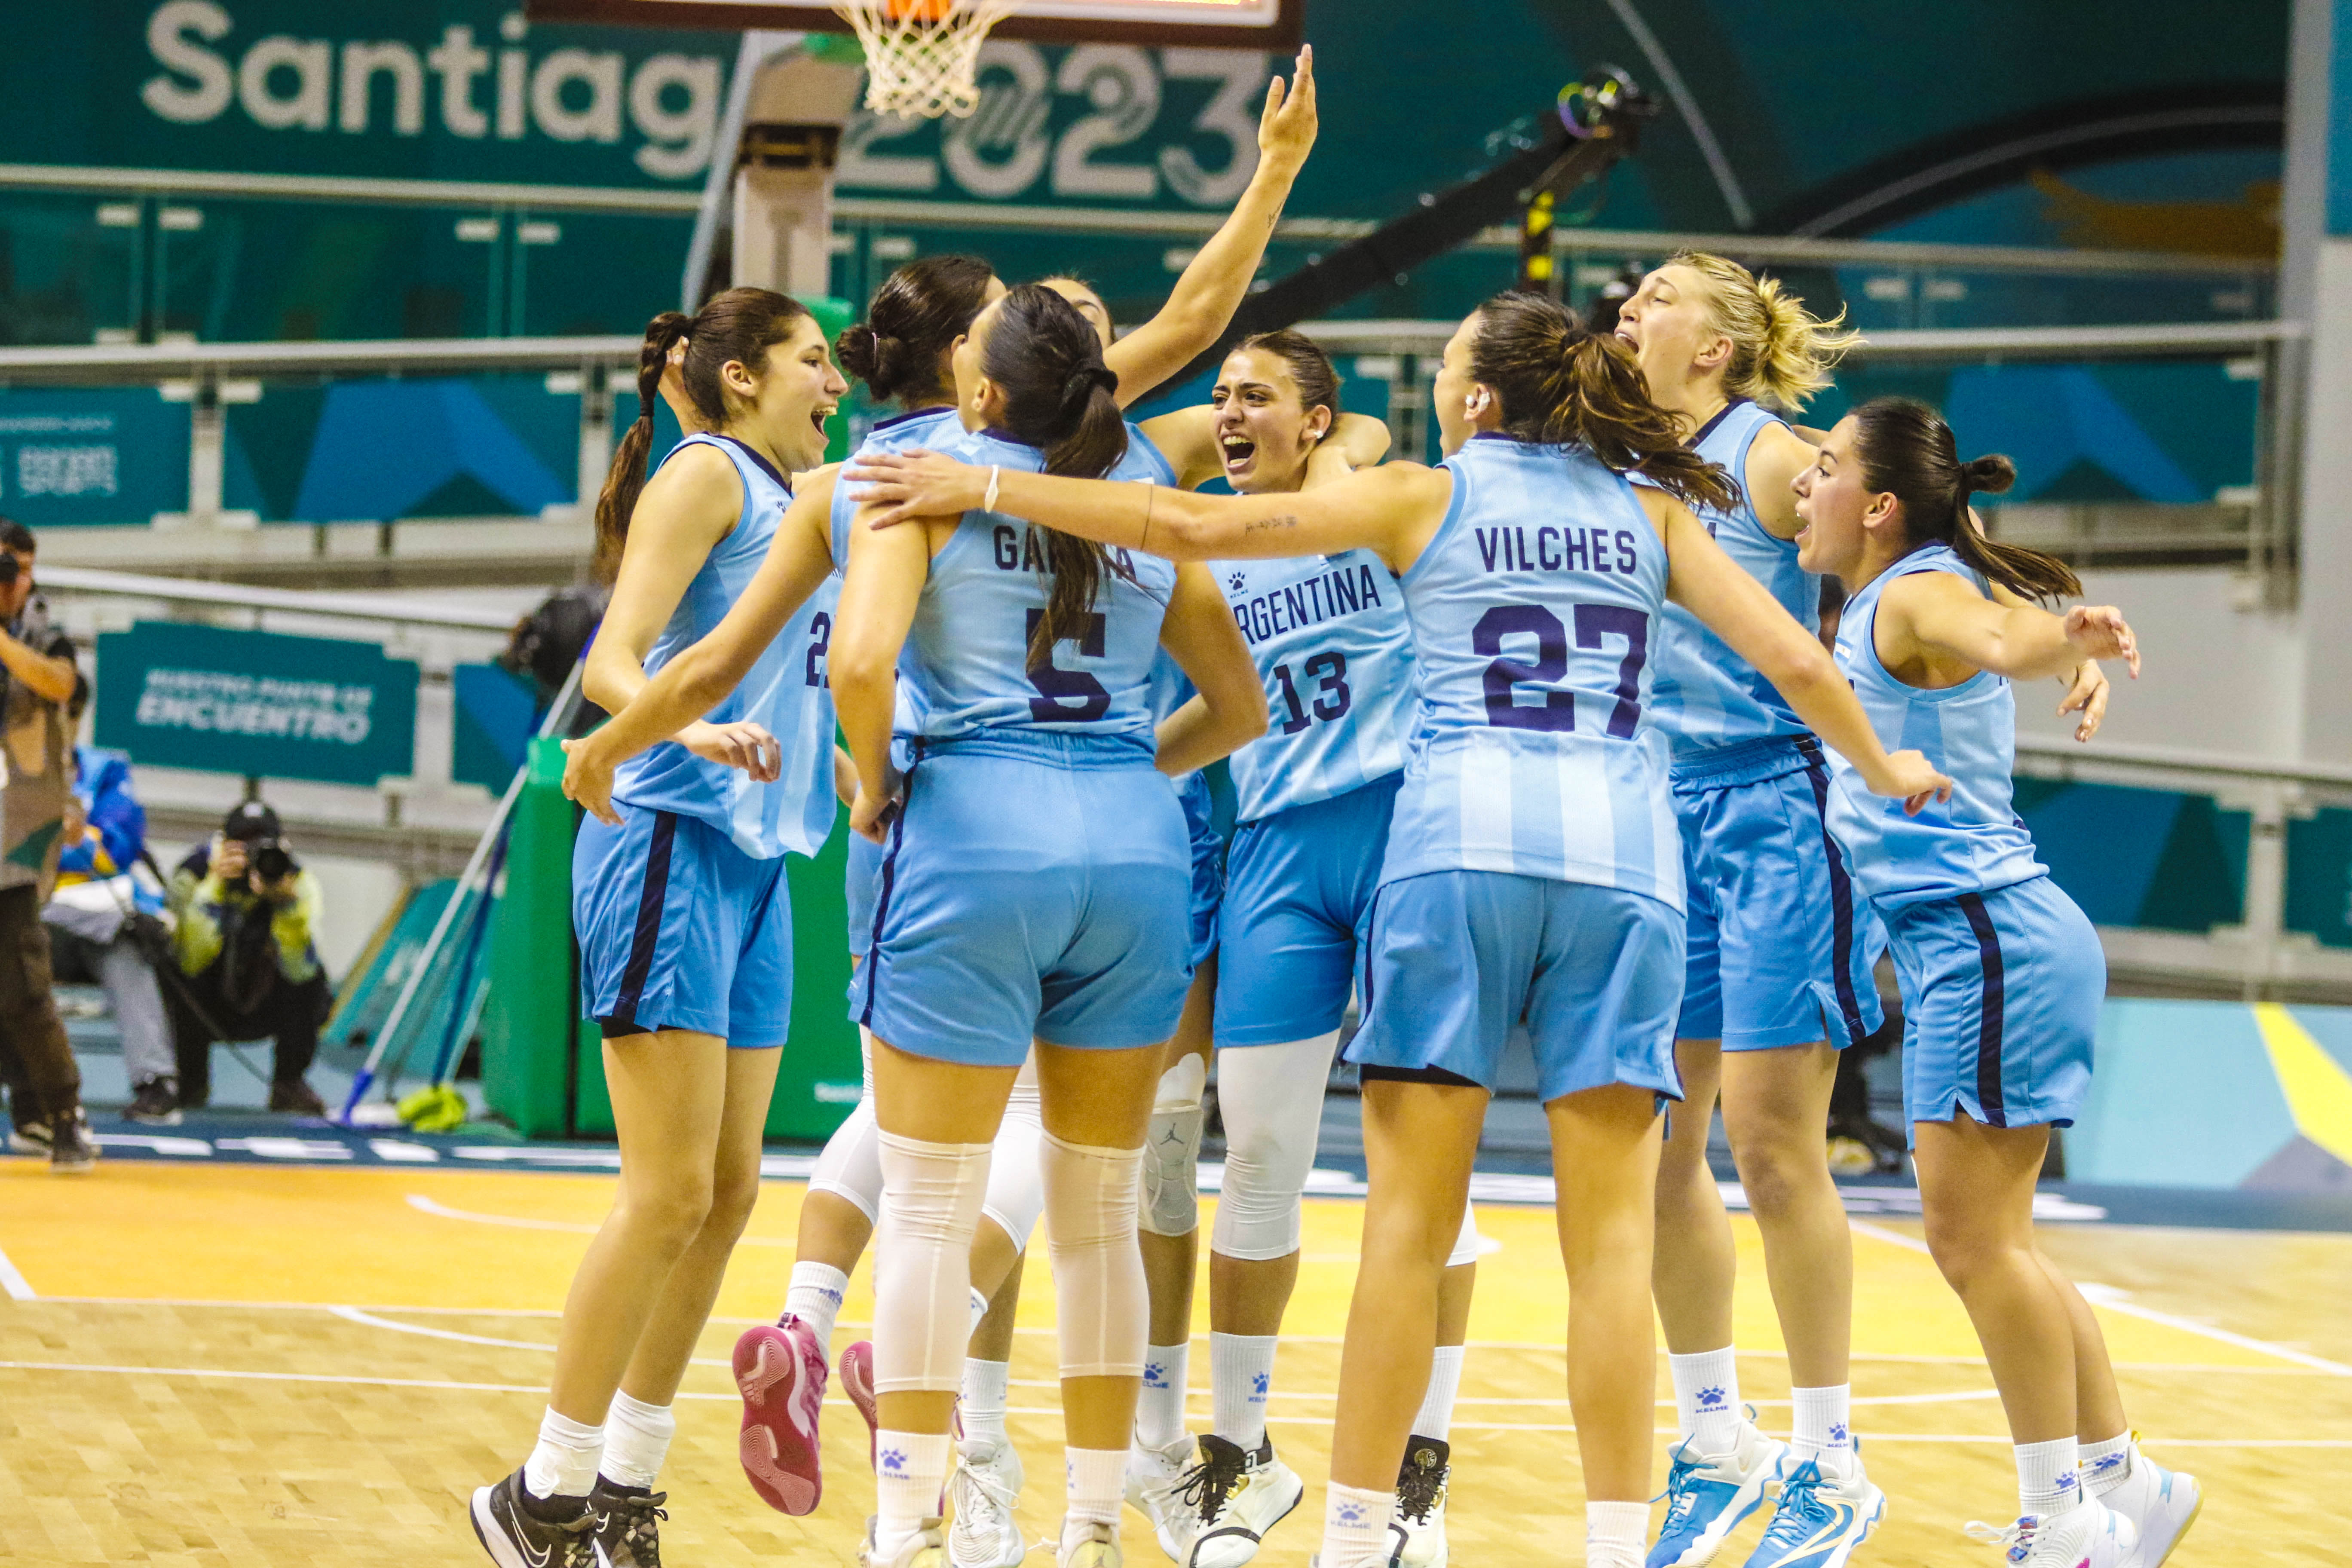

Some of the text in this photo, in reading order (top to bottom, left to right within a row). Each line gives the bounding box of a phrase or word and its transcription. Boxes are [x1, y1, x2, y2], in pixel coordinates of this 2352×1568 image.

[140, 0, 1269, 207] Santiag 2023
[1475, 527, 1636, 574] VILCHES
[1233, 564, 1381, 645] RGENTINA
[1026, 607, 1111, 723] 5
[1274, 651, 1351, 735] 13
[1472, 604, 1649, 739] 27
[137, 692, 371, 745] ENCUENTRO
[1695, 1405, 1729, 1413] KELME
